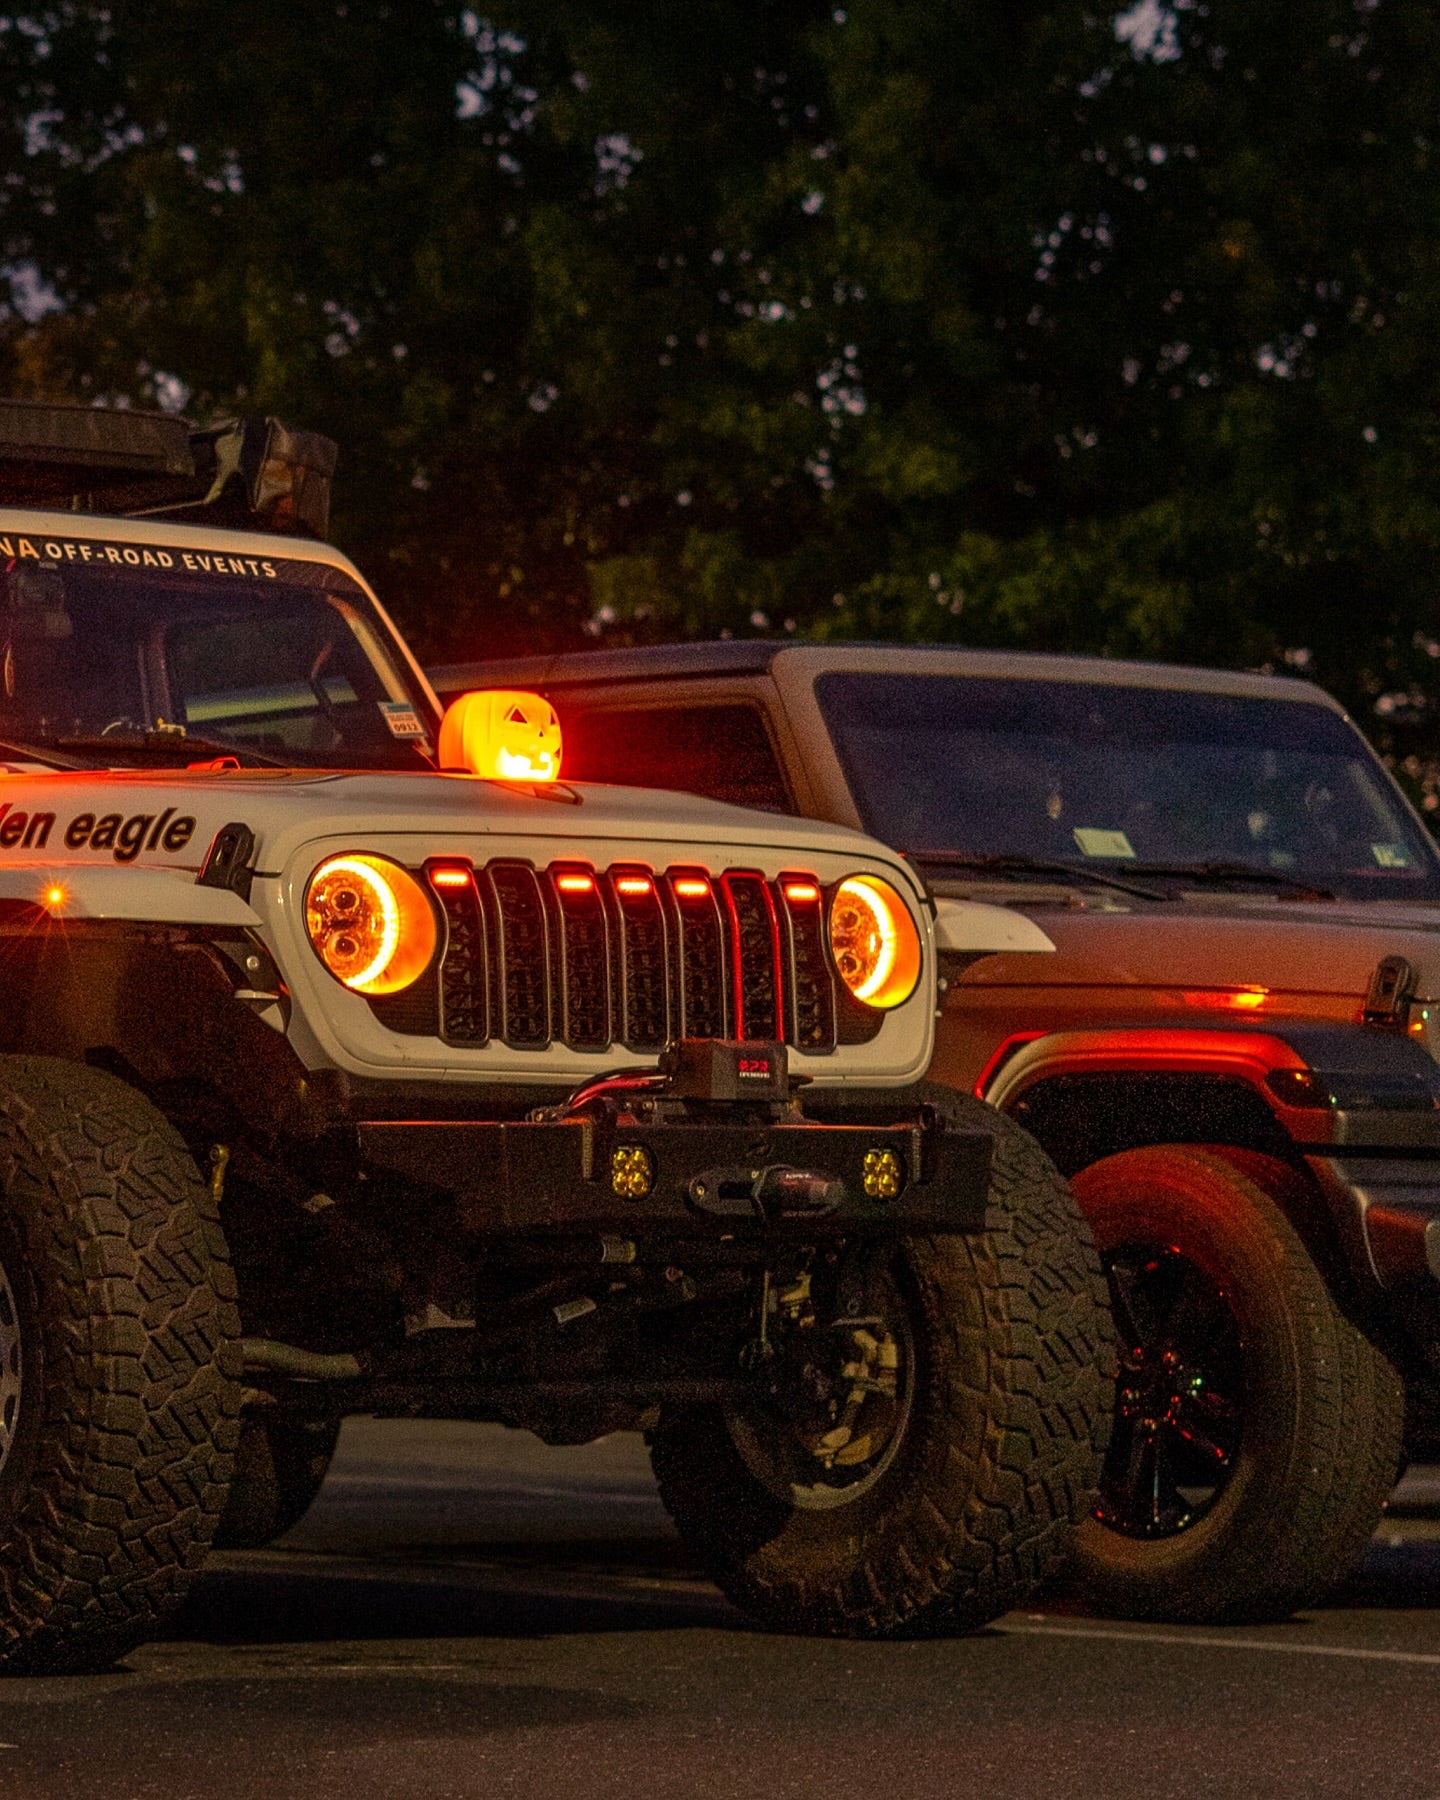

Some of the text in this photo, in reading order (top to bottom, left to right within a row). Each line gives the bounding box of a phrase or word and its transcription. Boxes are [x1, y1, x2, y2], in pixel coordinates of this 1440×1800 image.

[45, 541, 174, 568] OFF-ROAD
[181, 553, 277, 578] EVENTS
[64, 807, 197, 863] eagle
